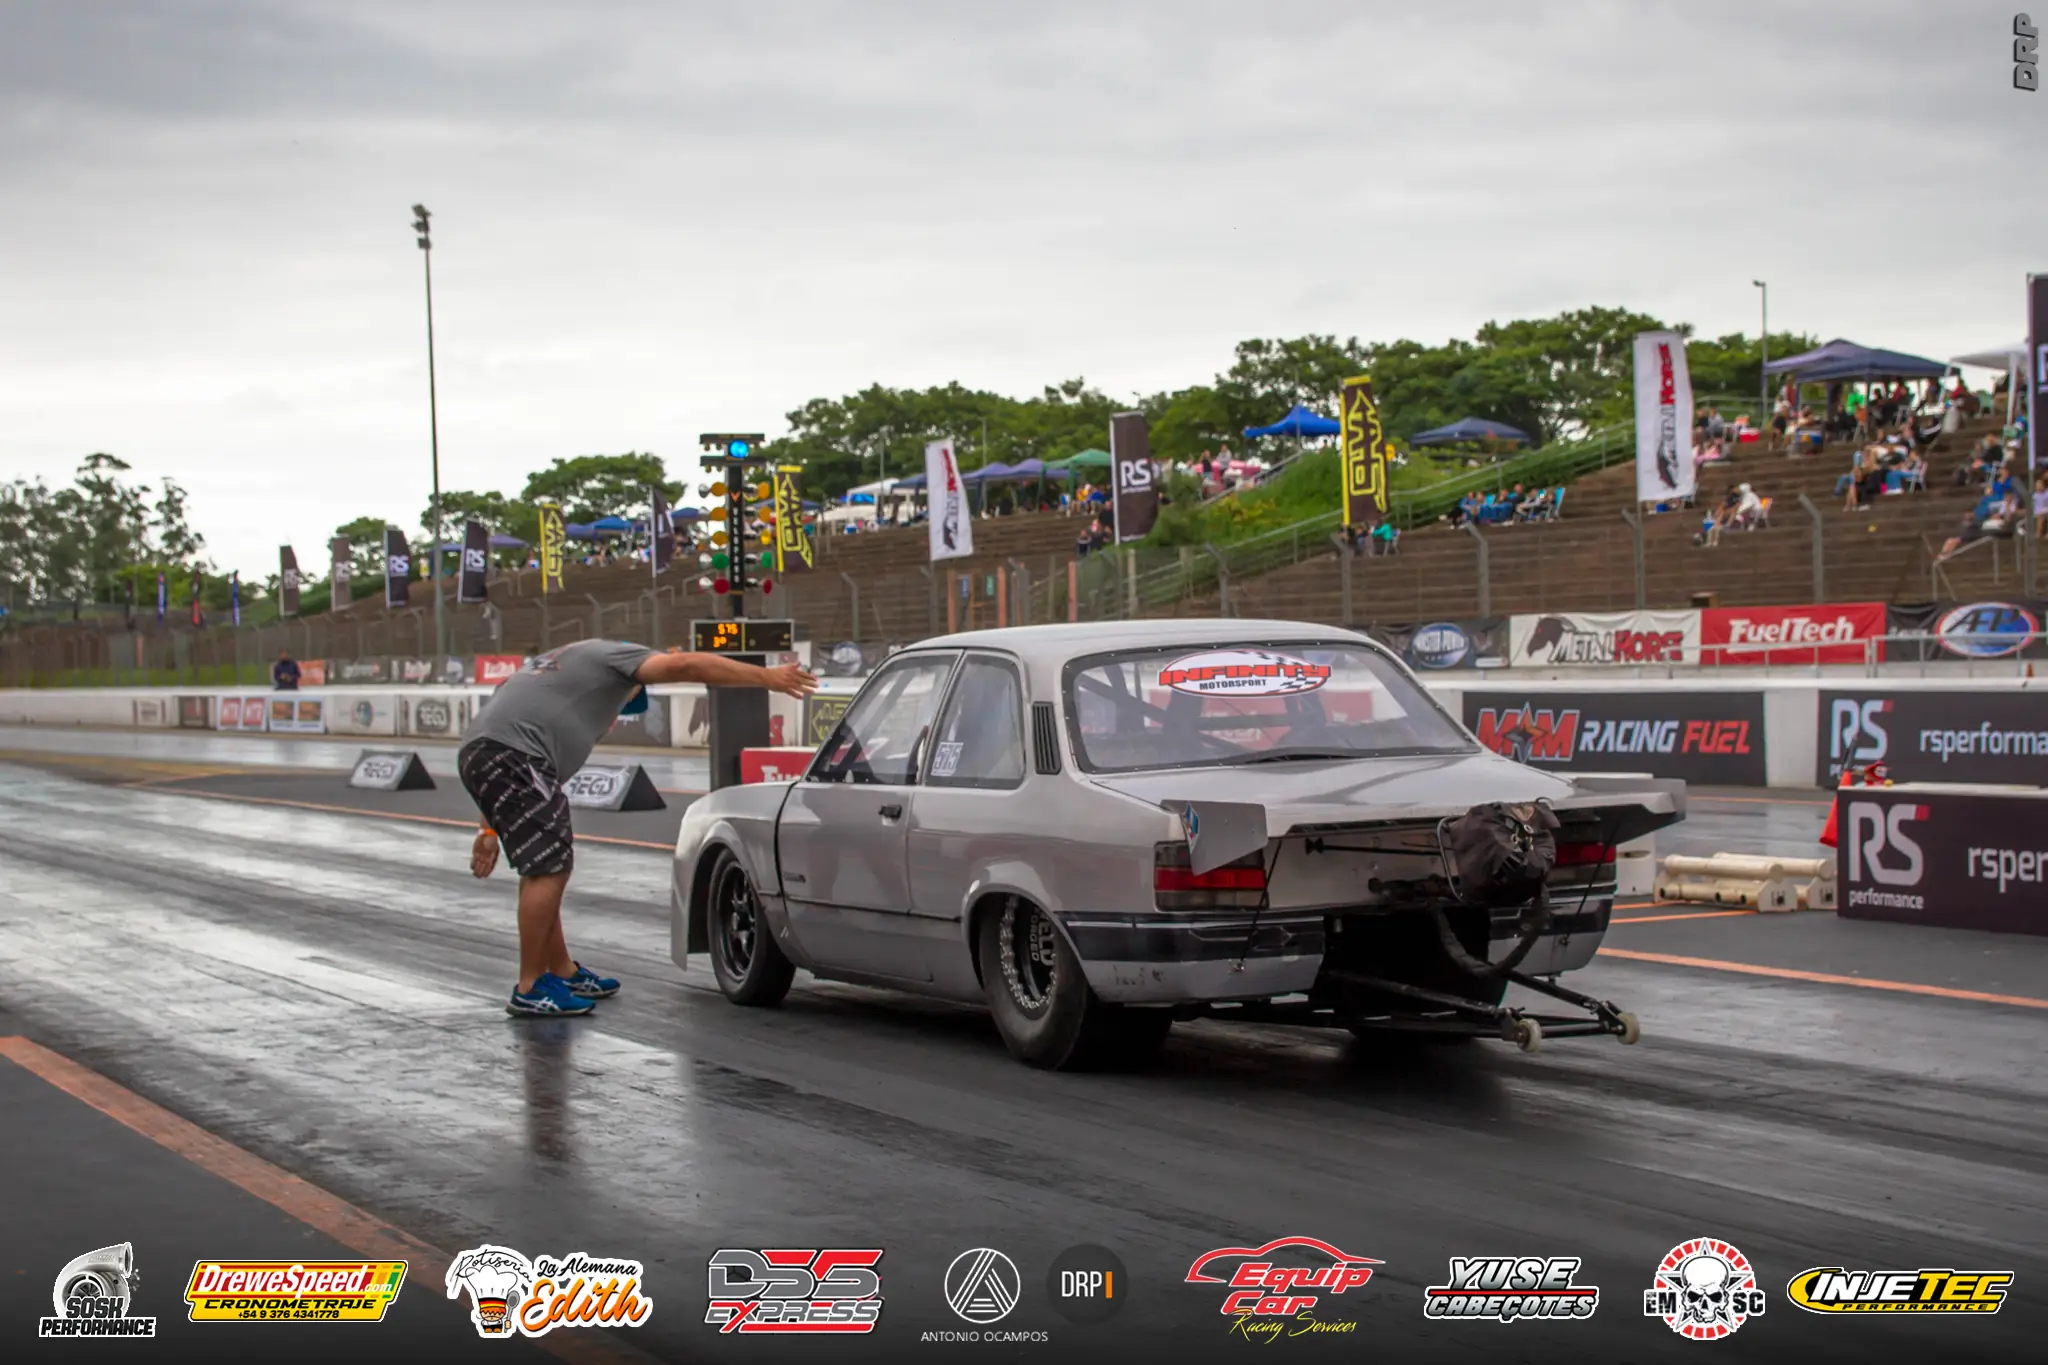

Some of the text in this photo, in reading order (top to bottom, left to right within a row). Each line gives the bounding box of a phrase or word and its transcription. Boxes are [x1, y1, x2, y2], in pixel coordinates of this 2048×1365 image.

[1120, 459, 1150, 487] RS
[389, 555, 409, 573] RS
[465, 549, 484, 567] RS
[1729, 615, 1855, 643] FuelTech
[1199, 679, 1267, 690] MOTORSPORT
[1579, 720, 1680, 753] RACING
[1681, 720, 1751, 754] FUEL
[1830, 699, 1888, 760] RS
[1849, 801, 1923, 886] RS
[1849, 888, 1924, 910] performance
